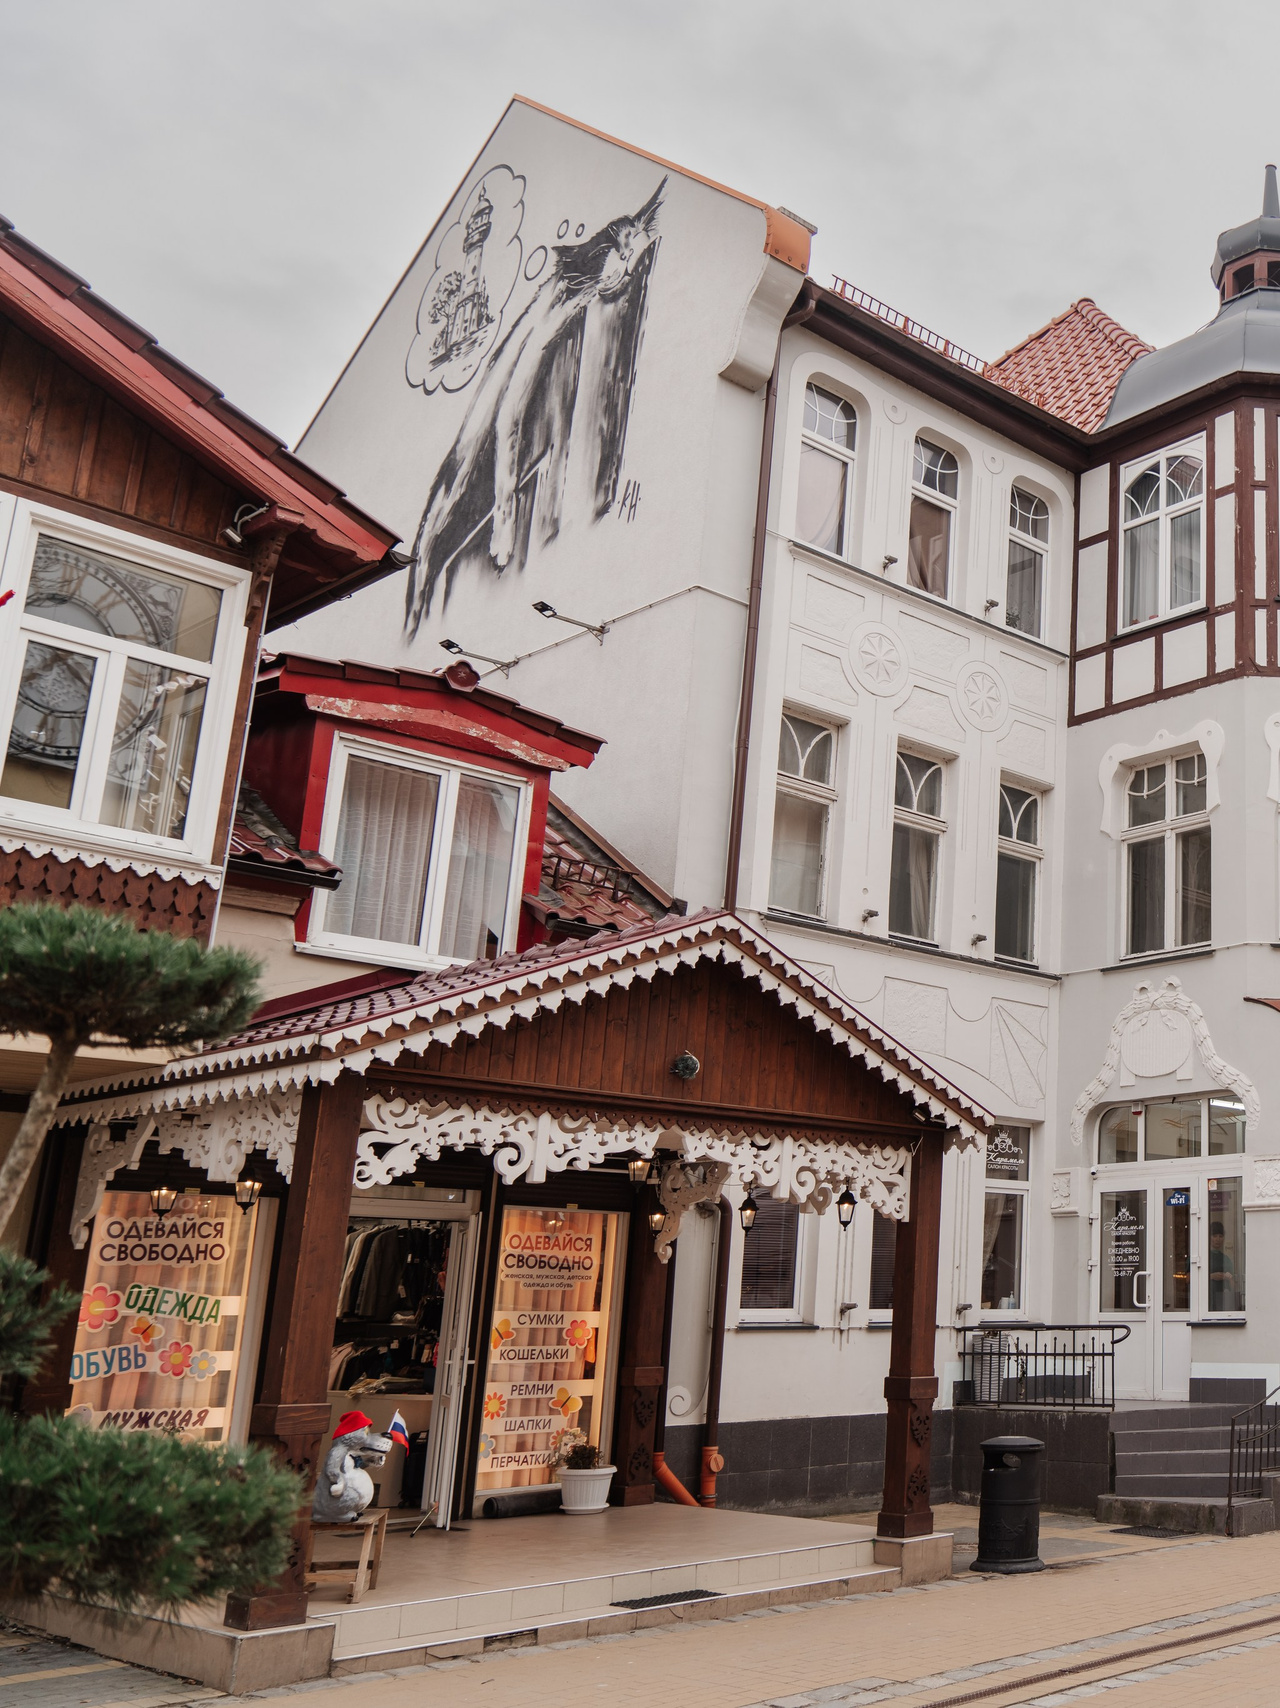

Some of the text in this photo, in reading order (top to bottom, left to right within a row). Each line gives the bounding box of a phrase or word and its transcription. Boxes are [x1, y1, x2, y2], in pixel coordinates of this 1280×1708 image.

[106, 1217, 225, 1241] ОДЕВАЙСЯ
[508, 1233, 593, 1252] ОДЕВАЙСЯ
[99, 1243, 226, 1264] СВОБОДНО
[503, 1253, 594, 1272] СВОБОДНО
[523, 1281, 549, 1289] одежда
[555, 1281, 573, 1289] обувь
[125, 1283, 222, 1324] ОДЕЖДА
[517, 1313, 564, 1326] СУМКИ
[70, 1345, 147, 1380] ОБУВЬ
[499, 1348, 569, 1361] КОШЕЛЬКИ
[510, 1383, 554, 1396] РЕМНИ
[100, 1408, 210, 1430] МУЖСКАЯ
[504, 1418, 552, 1432] ШАПКИ
[490, 1453, 552, 1469] ПЕРЧАТКИ
